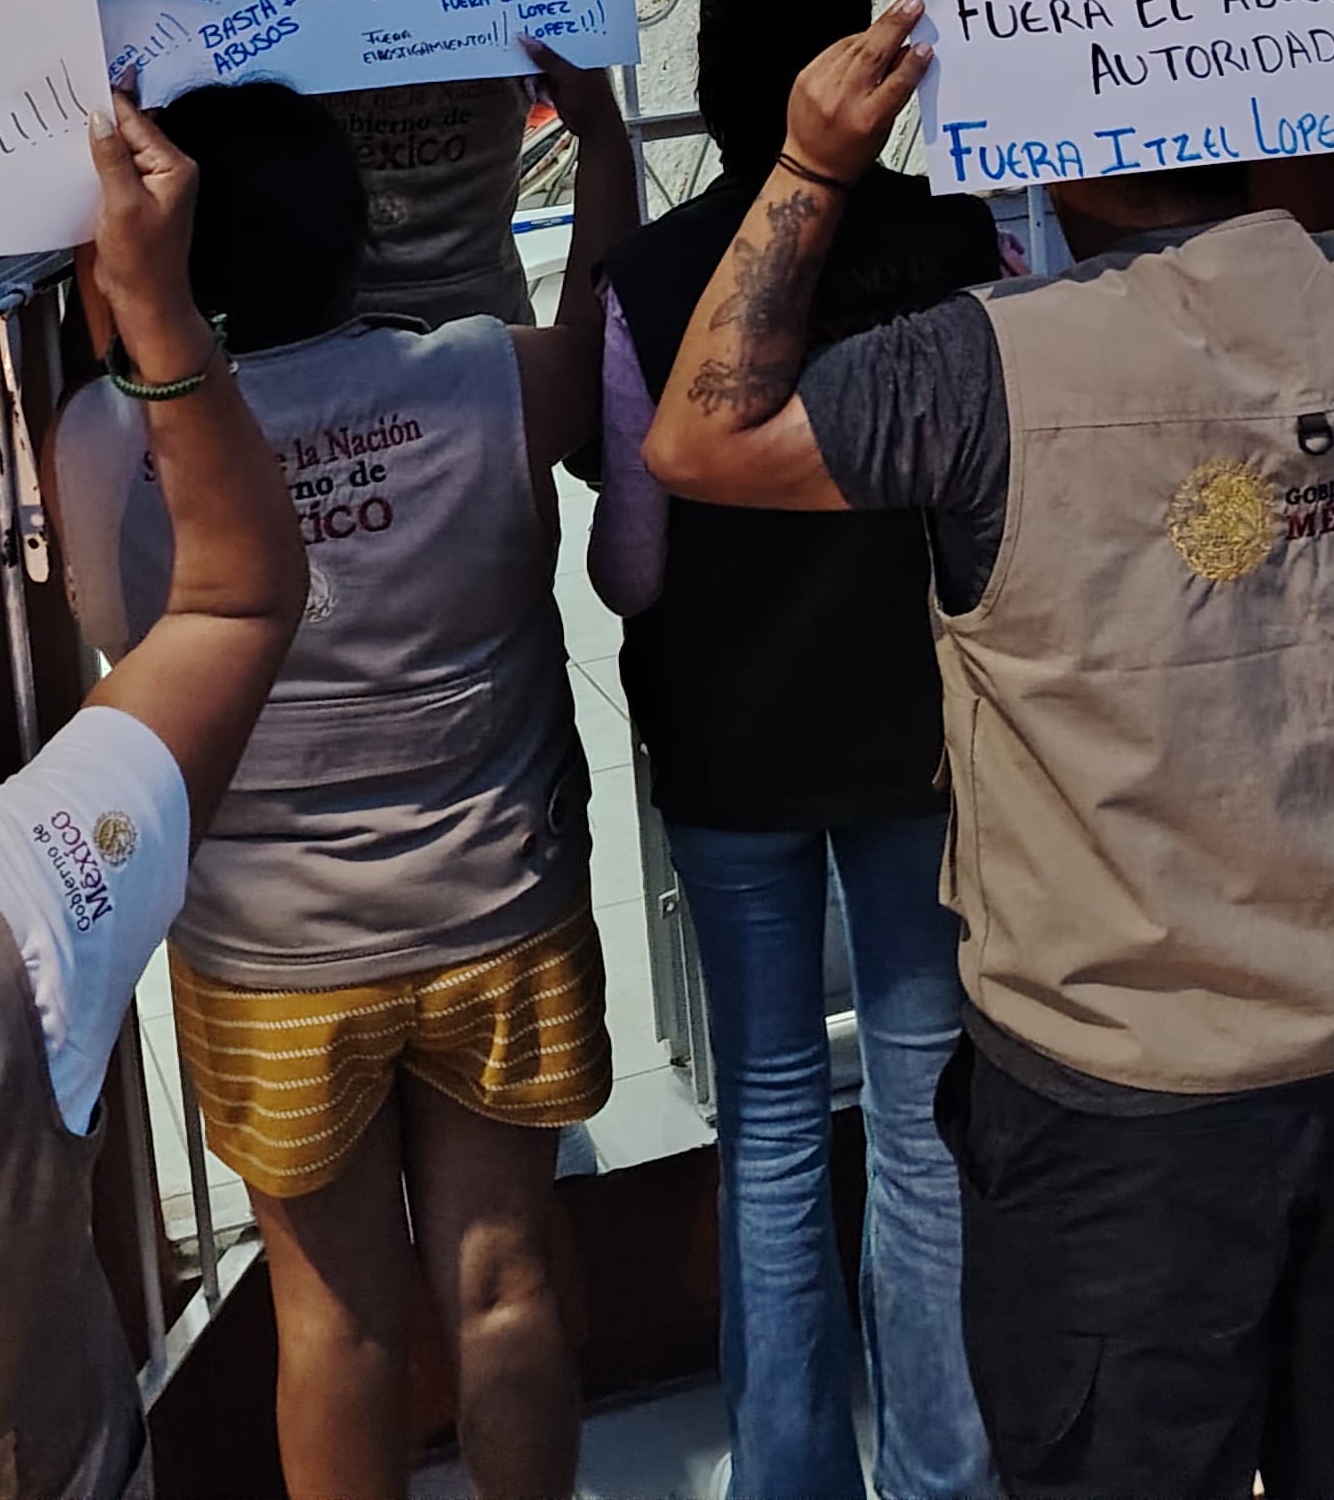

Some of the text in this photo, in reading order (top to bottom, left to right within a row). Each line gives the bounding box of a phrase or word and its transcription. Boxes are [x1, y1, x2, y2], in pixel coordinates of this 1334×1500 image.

[517, 0, 572, 20] LOPEZ
[212, 15, 301, 76] ABUSOS
[358, 132, 467, 171] éxico
[942, 119, 1085, 183] FUERA
[323, 412, 424, 464] Nación
[349, 460, 387, 489] de
[32, 823, 92, 932] Gobierno de
[50, 810, 114, 924] México
